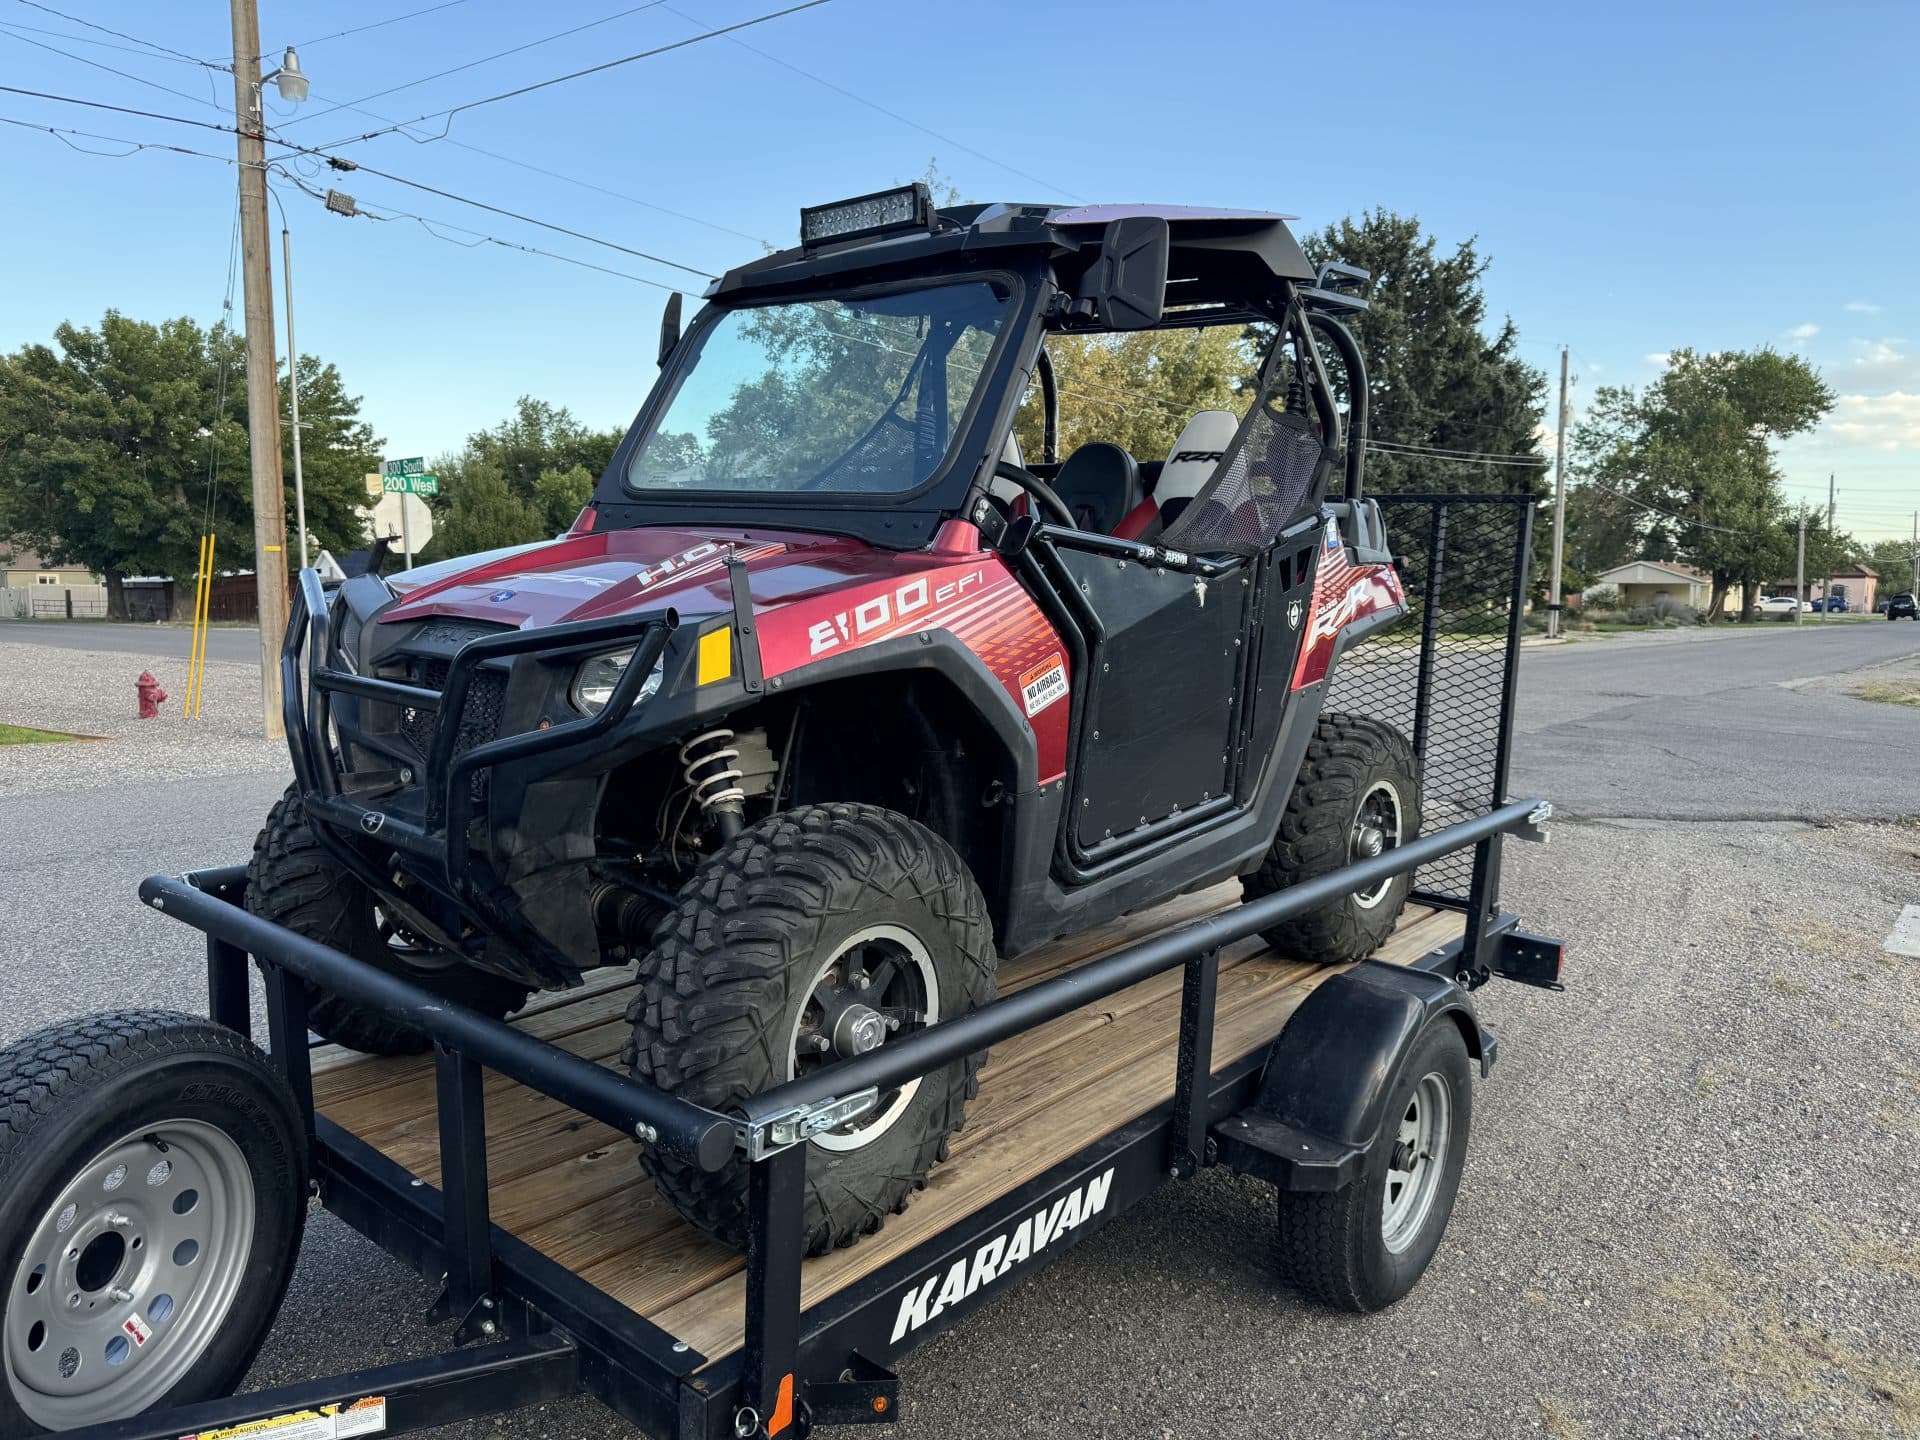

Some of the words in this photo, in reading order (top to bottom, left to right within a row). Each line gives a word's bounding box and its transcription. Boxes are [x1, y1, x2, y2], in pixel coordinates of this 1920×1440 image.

[403, 458, 424, 473] South
[384, 477, 407, 491] 200
[410, 478, 436, 493] West
[935, 569, 983, 604] EFI
[1305, 577, 1369, 654] RZR
[1027, 685, 1037, 700] NO
[1036, 669, 1062, 695] AIRBAGS
[890, 1167, 1115, 1345] KARAVAN
